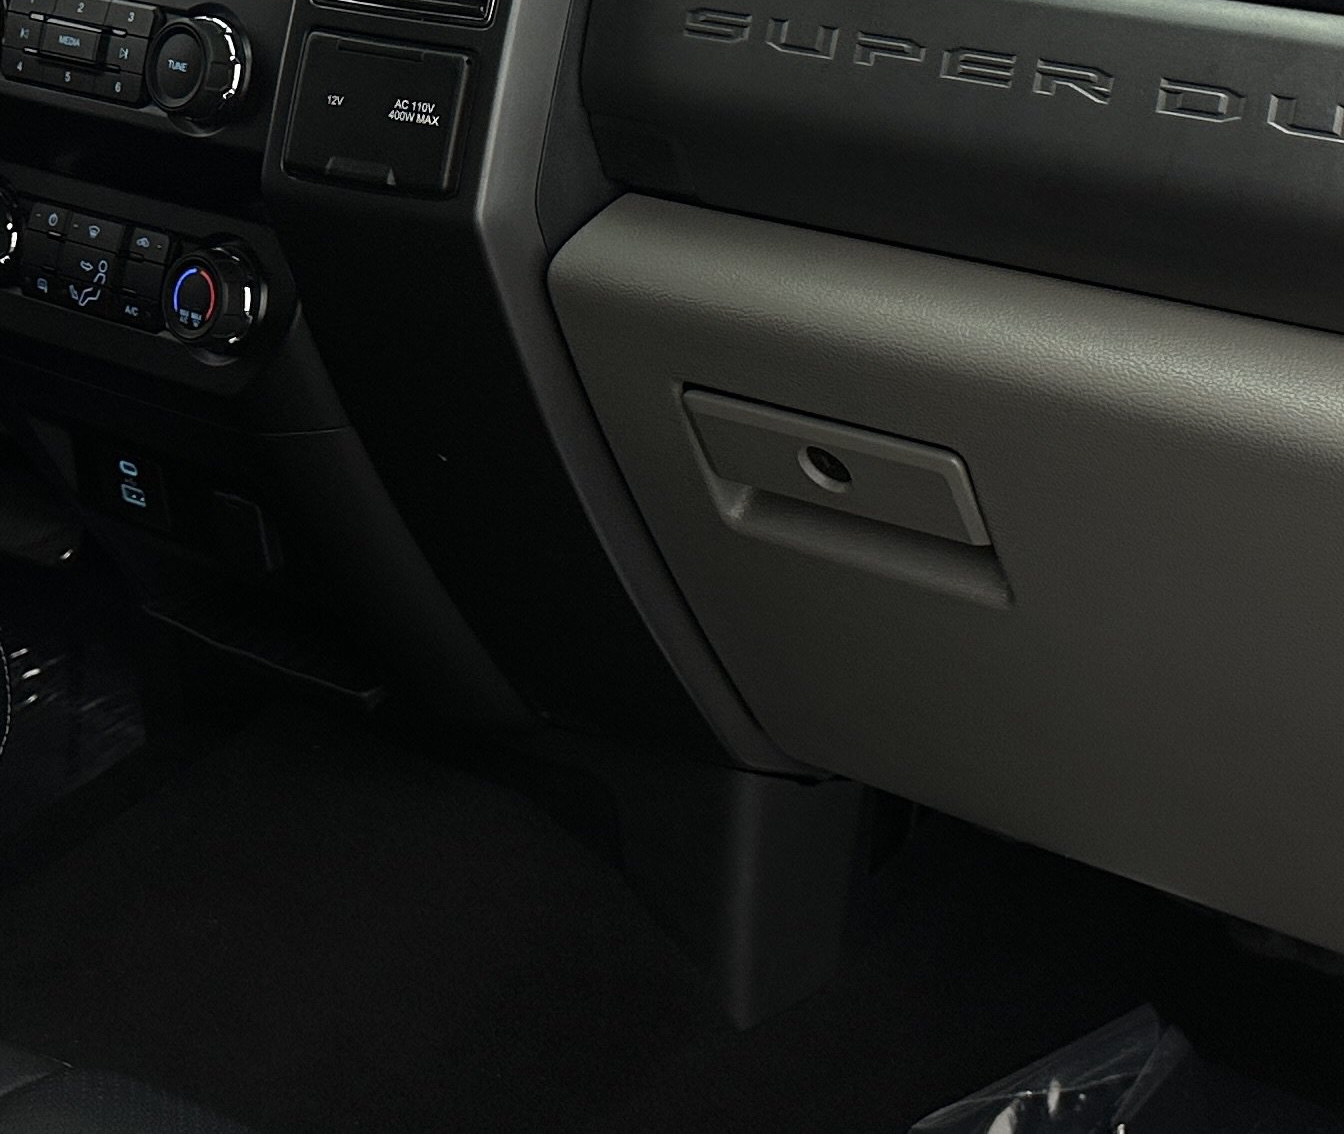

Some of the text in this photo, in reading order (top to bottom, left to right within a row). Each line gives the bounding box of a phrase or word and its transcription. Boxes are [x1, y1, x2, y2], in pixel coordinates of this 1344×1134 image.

[77, 2, 85, 13] 2
[127, 12, 135, 22] 3
[58, 35, 81, 47] MEDIA
[682, 6, 1115, 106] SUPER
[16, 62, 23, 72] 4
[167, 59, 189, 73] TUNE
[64, 71, 72, 82] 5
[114, 81, 122, 93] 6
[327, 94, 345, 106] 12V
[393, 98, 436, 114] AC 110V
[387, 109, 440, 127] 400W MAX
[124, 305, 139, 317] A/C
